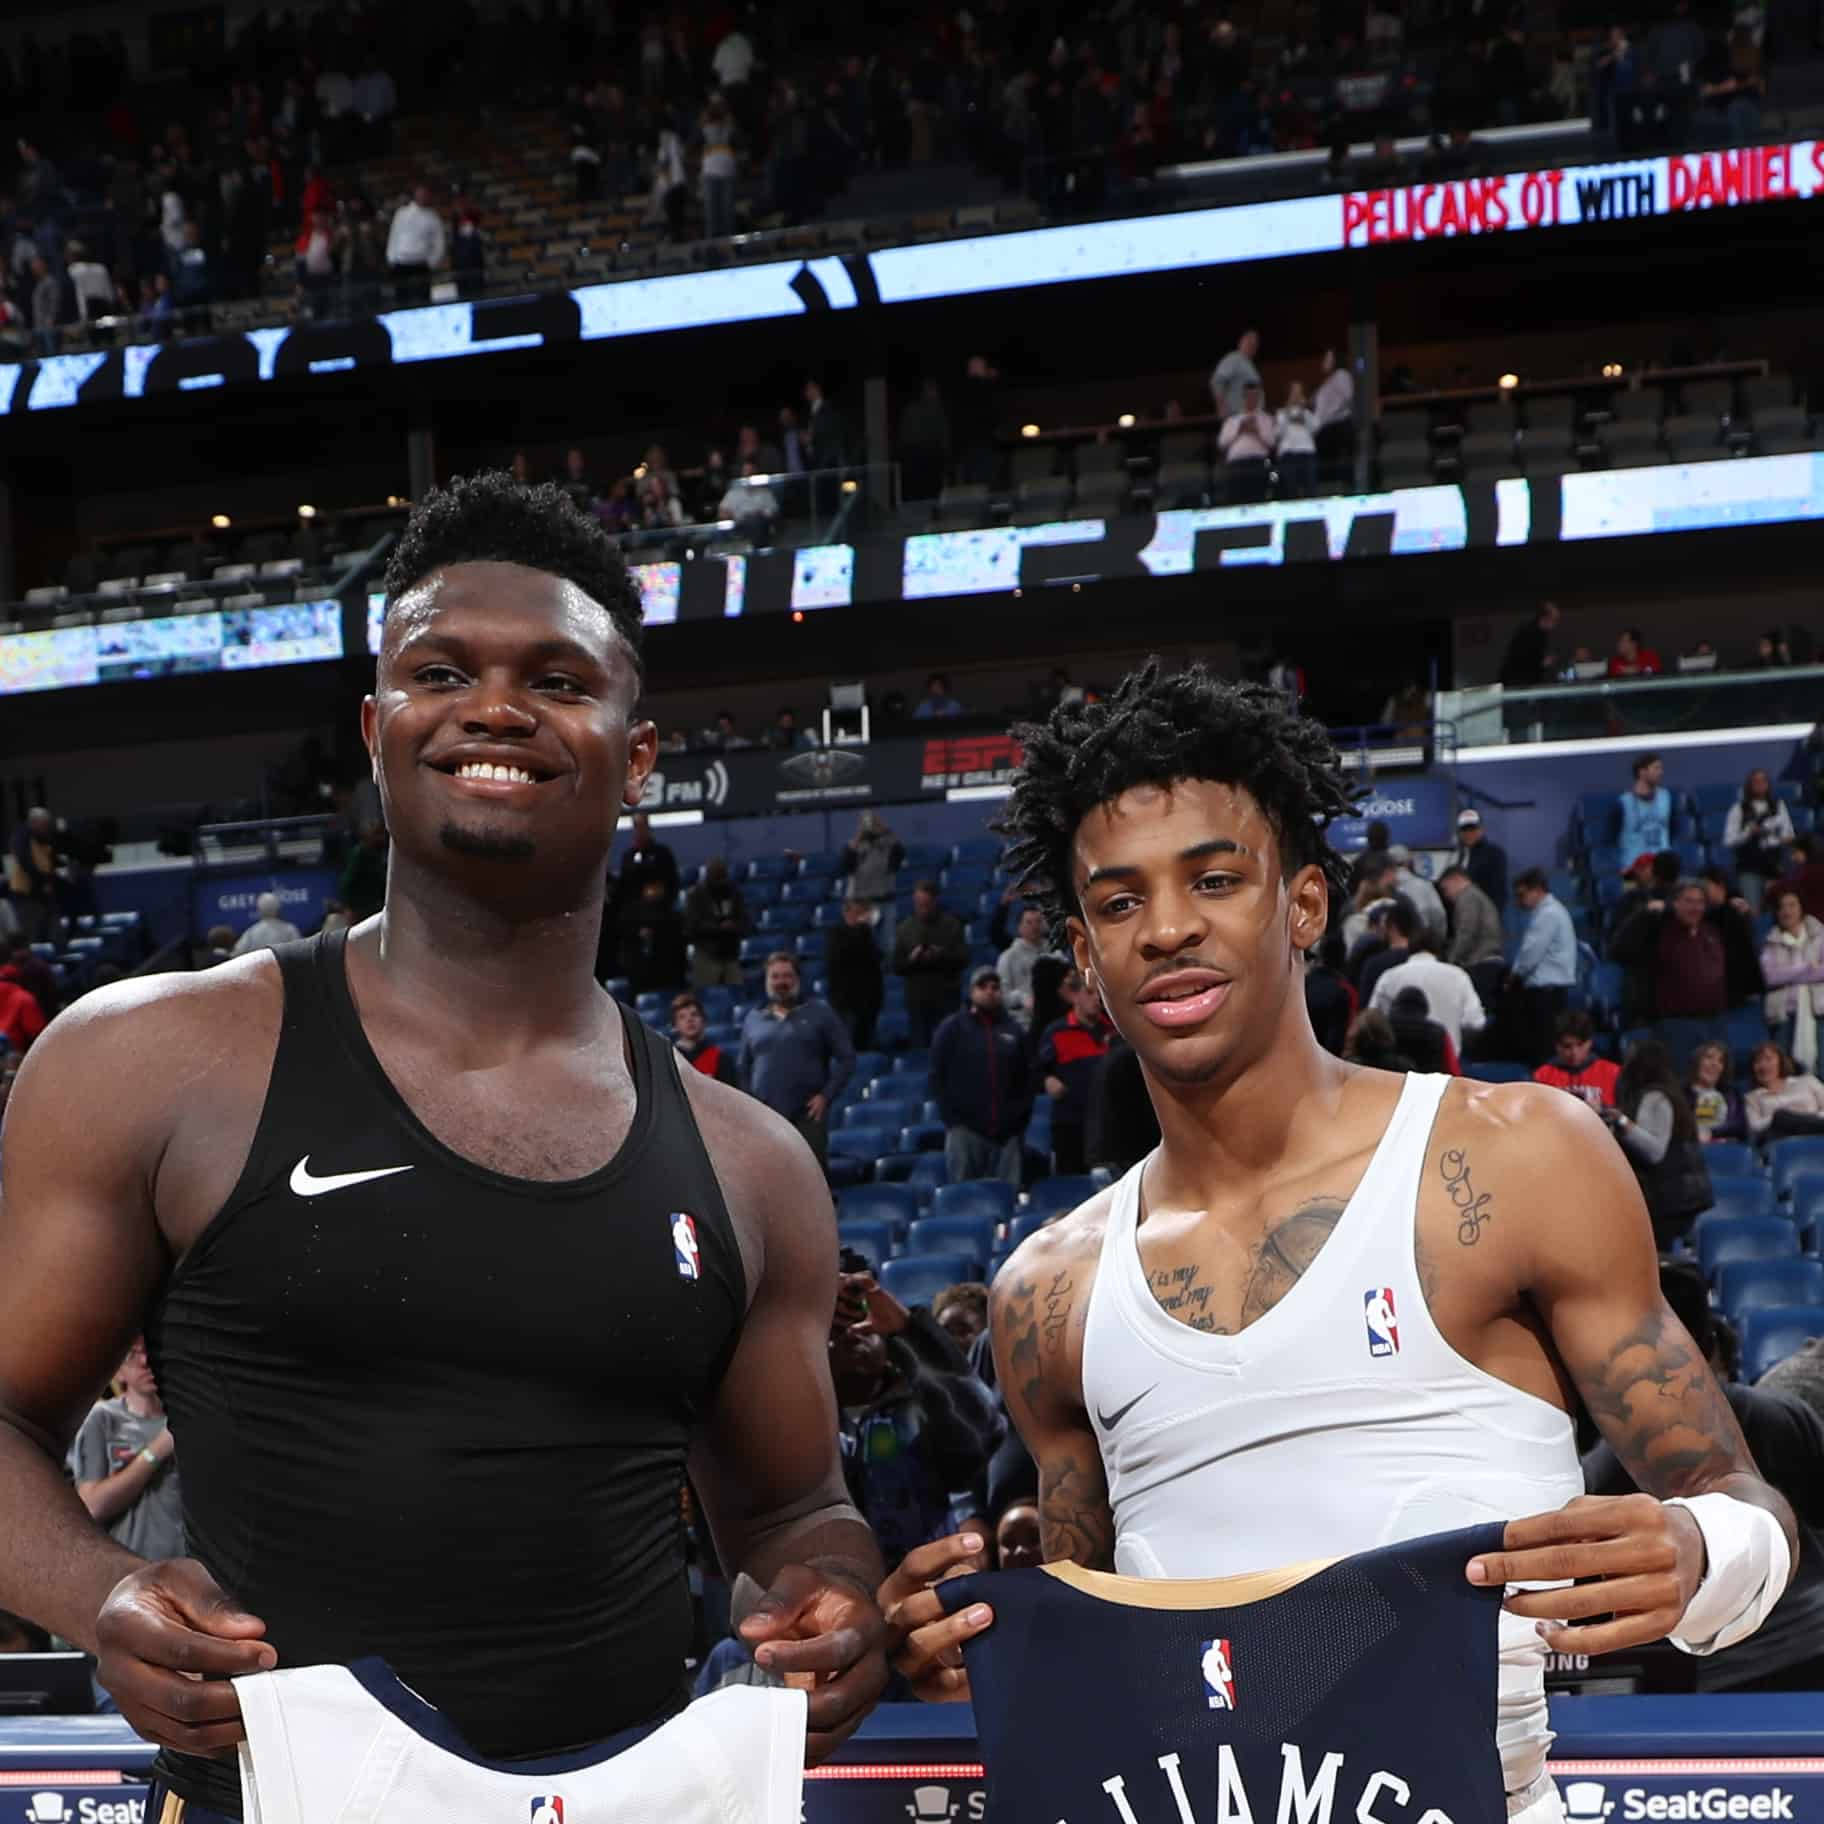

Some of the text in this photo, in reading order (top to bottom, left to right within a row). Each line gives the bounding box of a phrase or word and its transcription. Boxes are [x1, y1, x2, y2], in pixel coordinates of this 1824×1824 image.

[1343, 178, 1507, 245] PELICANS
[1522, 171, 1565, 224] OT
[1577, 172, 1656, 221] WITH
[1670, 146, 1794, 209] DANIEL
[1623, 1785, 1795, 1822] SeatGeek
